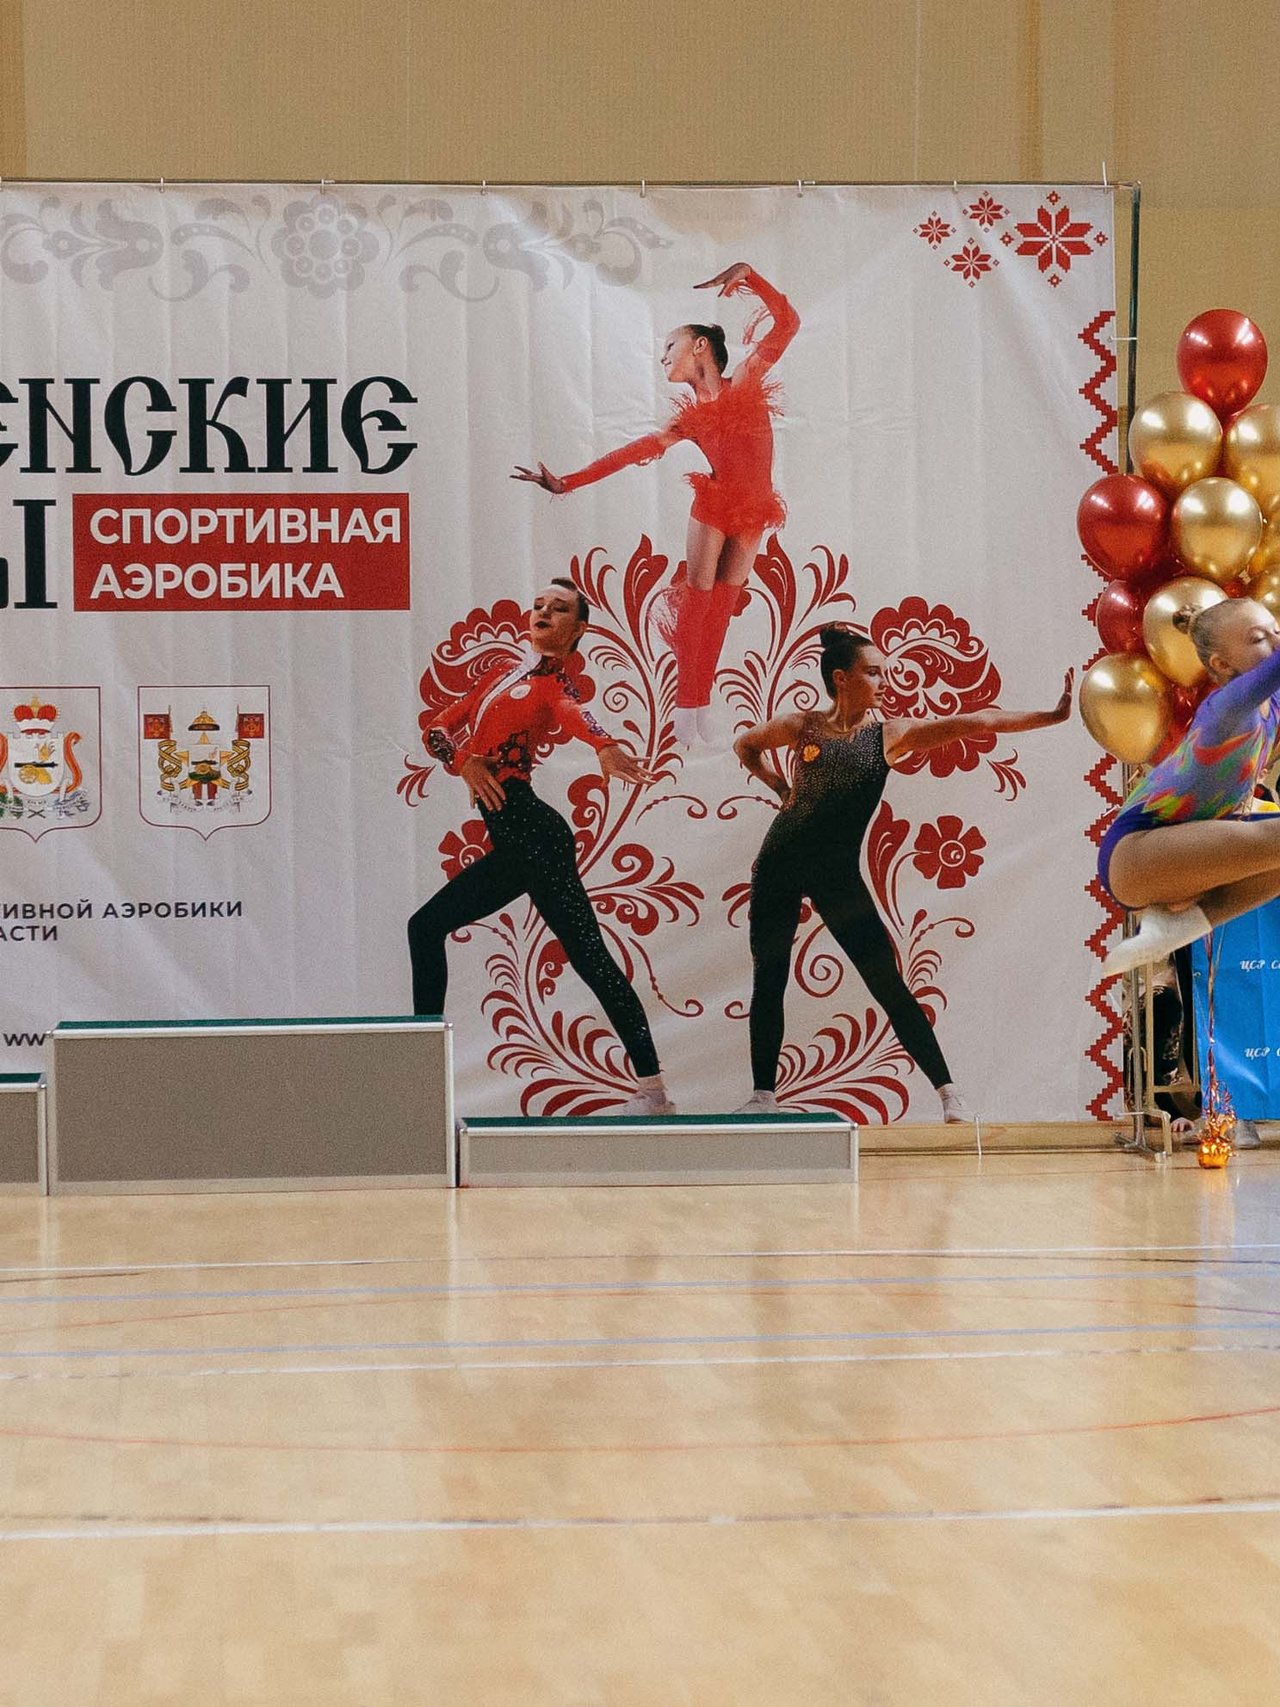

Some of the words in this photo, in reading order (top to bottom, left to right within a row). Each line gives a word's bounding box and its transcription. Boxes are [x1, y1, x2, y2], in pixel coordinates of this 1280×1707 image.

[0, 376, 418, 476] НСКИЕ
[90, 507, 401, 545] СПОРТИВНАЯ
[90, 562, 345, 600] АЭРОБИКА
[0, 899, 93, 919] ИВНОЙ
[102, 900, 242, 919] АЭРОБИКИ
[3, 1033, 47, 1047] ww
